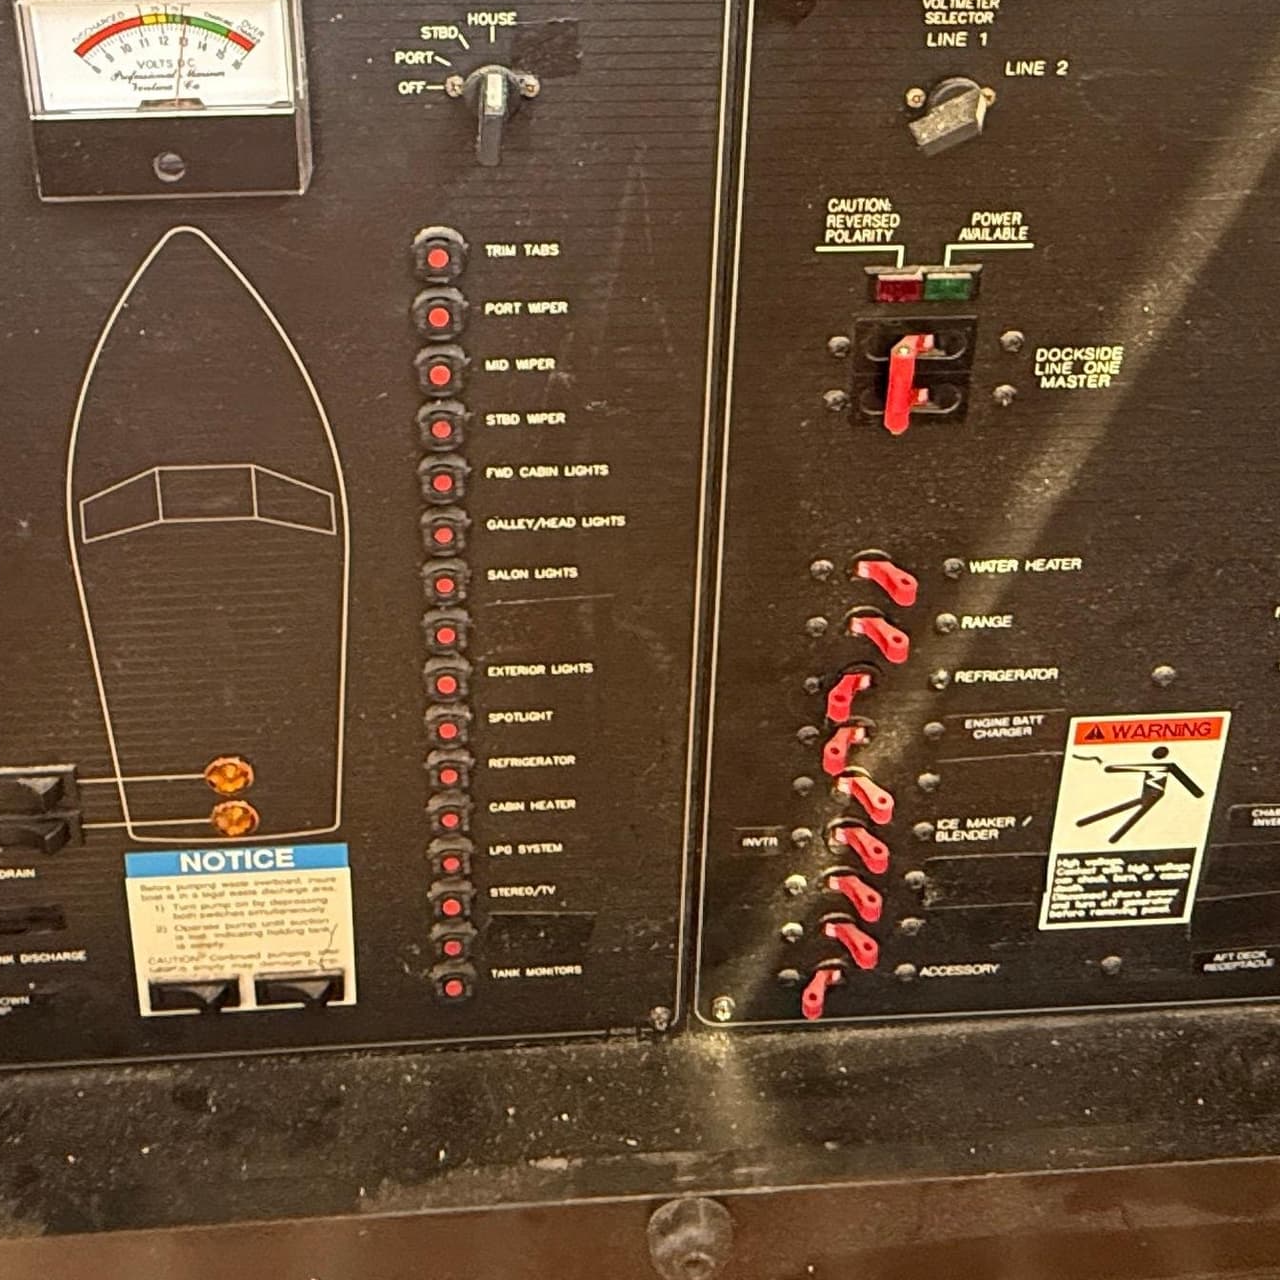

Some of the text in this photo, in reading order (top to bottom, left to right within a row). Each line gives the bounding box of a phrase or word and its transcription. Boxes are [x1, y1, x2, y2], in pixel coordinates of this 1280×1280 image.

[468, 13, 517, 25] HOUSE
[924, 11, 994, 25] SELECTOR
[421, 27, 458, 39] STBD
[927, 32, 988, 47] LINE 1
[394, 51, 434, 64] PORT
[1005, 61, 1069, 76] LINE 2
[398, 81, 426, 94] OFF
[826, 214, 900, 228] REVERSED
[972, 212, 1022, 226] POWER
[825, 229, 893, 244] POLARITY
[959, 226, 1029, 241] AVAILABLE
[486, 244, 559, 257] TRIM TABS
[1036, 347, 1124, 362] DOCKSIDE
[1035, 361, 1121, 377] LINE ONE
[1040, 374, 1111, 389] MASTER
[969, 558, 1082, 574] WATER HEATER
[961, 615, 1013, 629] RANGE
[955, 668, 1058, 683] REFRIGERATOR
[489, 711, 553, 723] SPOTLIGHT
[1112, 722, 1211, 739] WARNING
[937, 817, 1016, 830] ICE MAKER
[935, 830, 999, 842] BLENDER
[180, 848, 295, 872] NOTICE
[490, 885, 556, 897] STEREO/TV
[491, 965, 582, 979] TANK MONITORS
